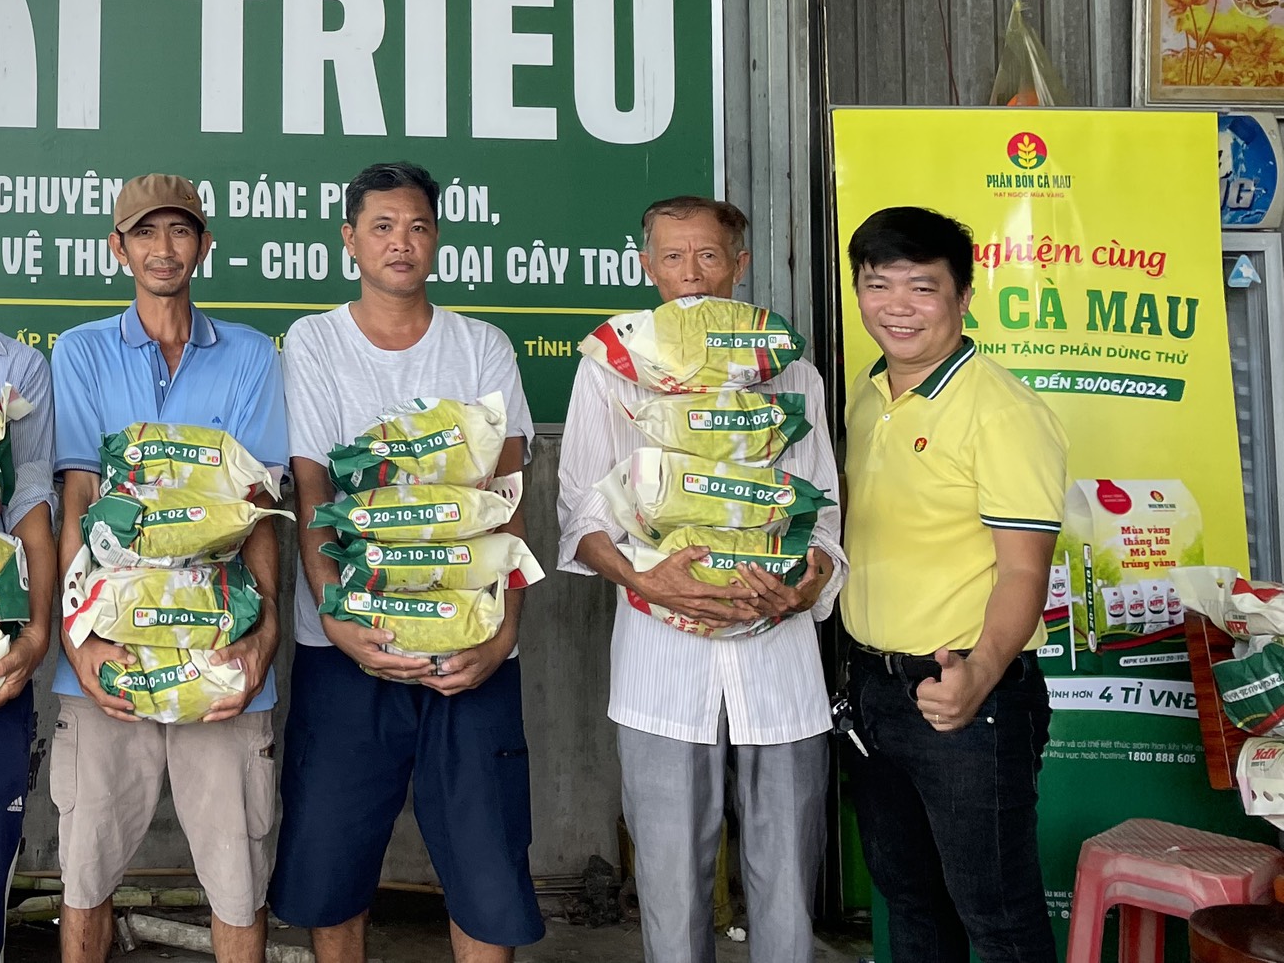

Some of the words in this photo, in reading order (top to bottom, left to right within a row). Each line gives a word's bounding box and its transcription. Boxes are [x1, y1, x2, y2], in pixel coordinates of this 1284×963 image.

[986, 172, 1012, 188] PHÂN
[1015, 172, 1034, 188] BÓN
[1037, 173, 1050, 188] CÀ
[1053, 175, 1071, 188] MAU
[229, 174, 307, 219] BÁN:
[436, 177, 500, 226] ÓN,
[1, 230, 43, 283] VỆ
[261, 242, 328, 281] CHO
[506, 240, 569, 285] CÂY
[580, 235, 657, 287] TRỒ
[1091, 239, 1167, 277] cùng
[999, 278, 1067, 330] CÀ
[1086, 289, 1199, 339] MAU
[524, 336, 572, 357] TỈNH
[975, 342, 1006, 354] ÌNH
[1011, 341, 1055, 357] TẶNG
[1060, 342, 1102, 357] PHÂN
[1106, 345, 1151, 361] DÙNG
[1155, 350, 1189, 365] THỬ
[1034, 373, 1071, 389] ĐẾN
[1075, 377, 1168, 397] 30/06/2024
[710, 482, 772, 501] 20-10-10
[143, 509, 184, 521] 20-10-
[373, 508, 434, 523] 20-10-10
[1121, 526, 1143, 535] Mùa
[1147, 526, 1171, 536] vàng
[385, 549, 445, 560] 20-10-10
[1150, 548, 1167, 556] bao
[1122, 559, 1150, 569] trúng
[373, 598, 435, 612] 20-10-10
[1129, 603, 1145, 611] NPK
[1148, 599, 1164, 608] NPK
[1226, 620, 1250, 635] NPK
[1038, 647, 1060, 655] 10-10
[1072, 690, 1093, 699] HƠN
[1098, 686, 1114, 703] 4
[1121, 681, 1144, 705] TỈ
[1149, 689, 1197, 710] VNĐ
[1128, 751, 1150, 762] 1800
[1155, 752, 1175, 763] 888
[1177, 753, 1196, 763] 606
[1252, 748, 1281, 761] NPK
